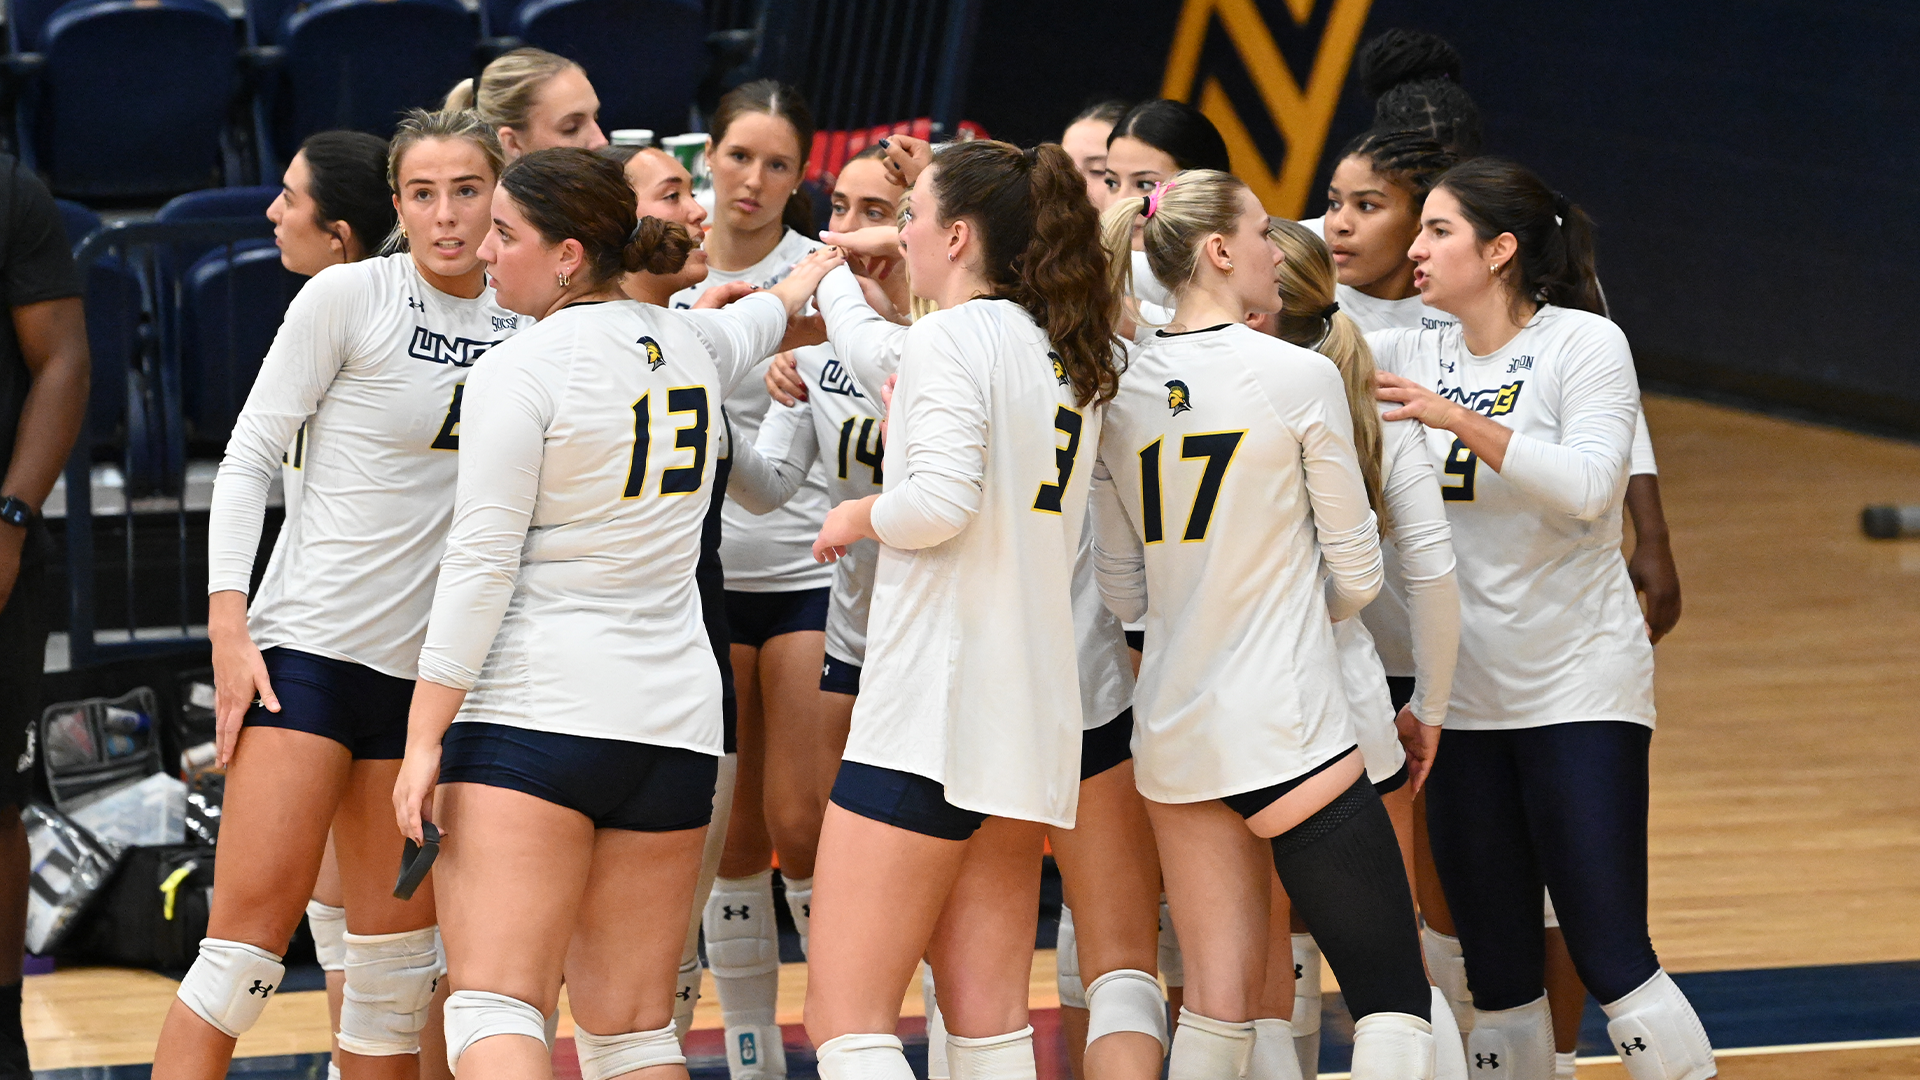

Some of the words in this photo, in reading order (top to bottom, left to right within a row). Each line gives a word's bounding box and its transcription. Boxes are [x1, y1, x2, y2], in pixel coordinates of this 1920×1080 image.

[408, 325, 503, 367] UNC
[620, 384, 710, 501] 13
[838, 414, 884, 486] 14
[1031, 402, 1083, 516] 3
[1137, 428, 1249, 546] 17
[1441, 436, 1479, 503] 9
